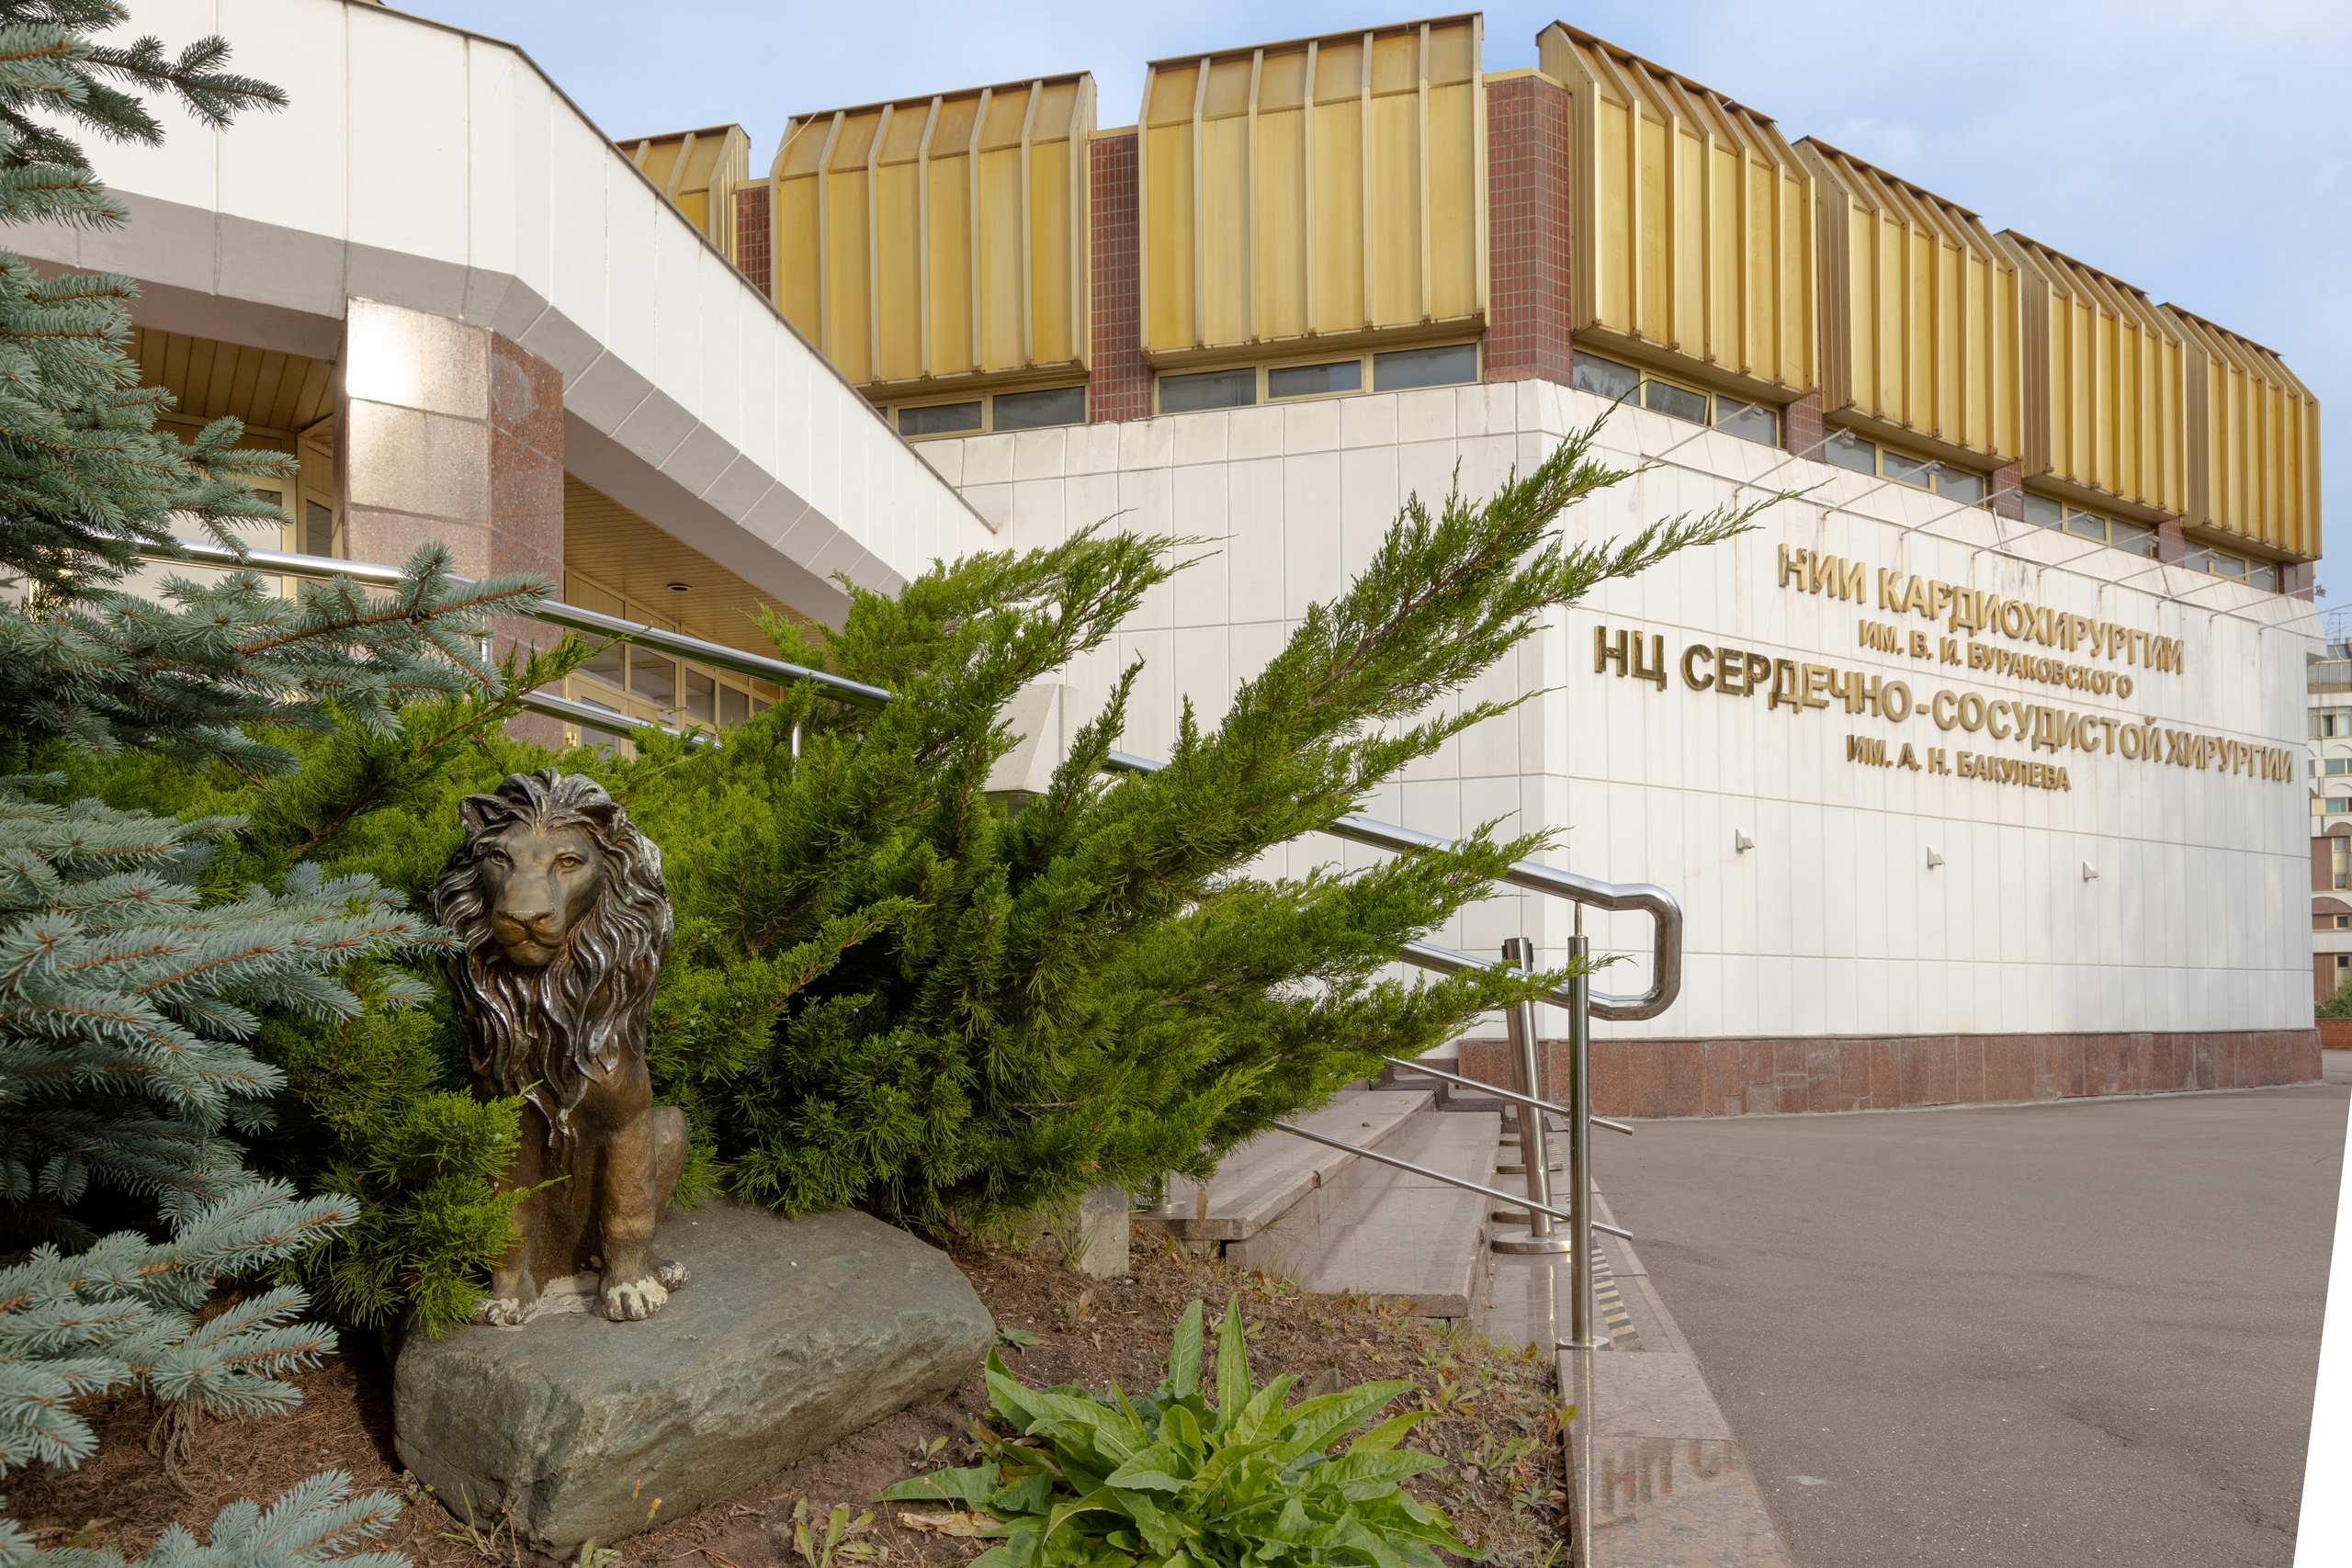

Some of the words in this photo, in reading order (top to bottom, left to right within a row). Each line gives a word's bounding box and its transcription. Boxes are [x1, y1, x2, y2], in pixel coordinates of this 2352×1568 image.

[1778, 543, 1867, 604] НИИ
[1878, 567, 2184, 675] КАРДИОХИРУРГИИ
[1859, 618, 1905, 654] ИМ.
[1909, 629, 1934, 660] В.
[1939, 636, 1963, 666] И.
[1967, 641, 2133, 699] БУРАКОВСКОГО
[1594, 625, 1668, 692] НЦ
[1680, 643, 2163, 762] СЕРДЕЧНО-СОСУДИСТОЙ
[2165, 728, 2295, 783] ХИРУРГИИ
[1847, 734, 1894, 768] ИМ.
[1897, 742, 1923, 771] А.
[1928, 747, 1952, 775] Н.
[1957, 750, 2073, 792] БАКУЛЕВА
